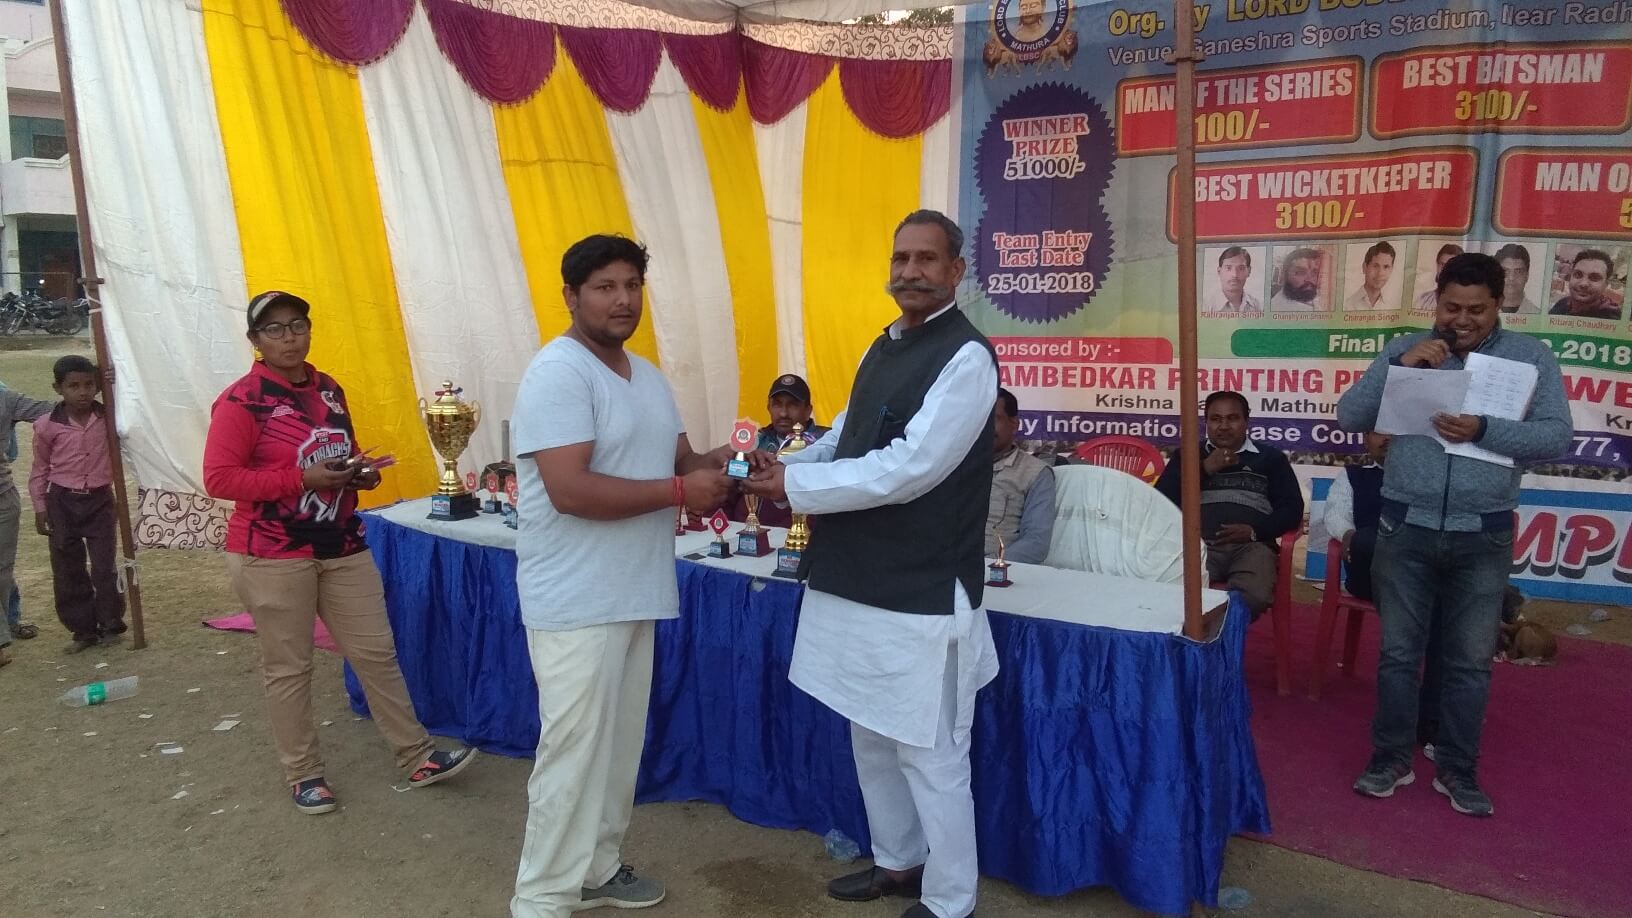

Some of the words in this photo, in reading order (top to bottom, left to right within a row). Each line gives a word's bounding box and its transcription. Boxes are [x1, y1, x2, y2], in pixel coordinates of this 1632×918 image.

[1109, 9, 1165, 38] Org.
[1302, 18, 1381, 48] Sports
[1390, 9, 1495, 38] Stadium,
[1010, 38, 1051, 51] MATHURA
[1403, 55, 1472, 89] BEST
[1476, 53, 1606, 84] BATSMAN
[1124, 85, 1175, 115] MAN
[1215, 76, 1259, 106] THE
[1264, 67, 1353, 102] SERIES
[1455, 90, 1538, 121] 3100/-
[1004, 115, 1089, 140] WINNER
[1014, 137, 1077, 158] PRIZE
[1006, 157, 1085, 179] 51000/-
[1534, 162, 1602, 192] MAN
[1608, 162, 1632, 193] O
[1195, 174, 1253, 203] BEST
[1257, 160, 1452, 199] WICKETKEEPER
[1276, 199, 1365, 229] 3100/-
[994, 233, 1038, 249] Team
[1043, 231, 1091, 252] Entry
[1000, 250, 1036, 266] Last
[1041, 250, 1083, 266] Date
[989, 274, 1094, 293] 25-01-2018
[1505, 316, 1527, 325] Sahid
[1078, 340, 1101, 360] by
[1328, 333, 1385, 354] Final
[999, 365, 1156, 390] AMBEDKAR
[1095, 393, 1174, 410] Krishna
[1046, 415, 1182, 438] Informatio
